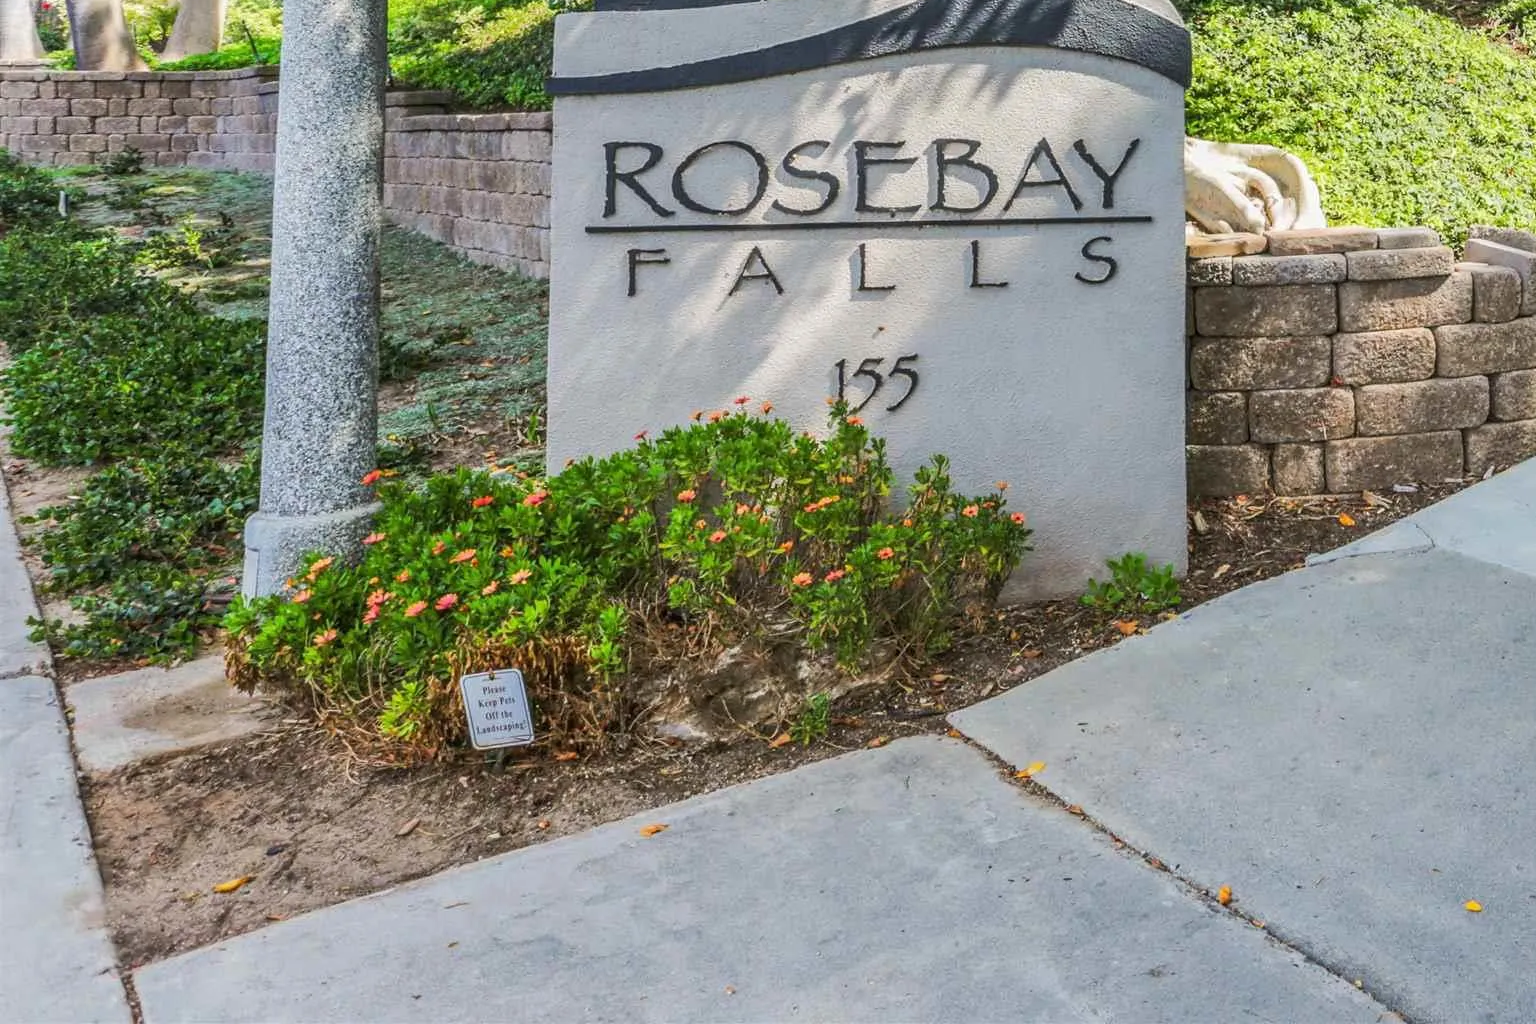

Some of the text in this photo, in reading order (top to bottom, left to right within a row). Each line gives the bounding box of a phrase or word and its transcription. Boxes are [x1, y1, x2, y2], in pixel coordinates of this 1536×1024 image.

[602, 136, 1141, 218] ROSEBAY
[627, 235, 1119, 297] FALLS
[835, 352, 919, 416] 155
[478, 696, 516, 708] Keep Pets
[482, 686, 506, 695] Please
[485, 710, 513, 720] Off the
